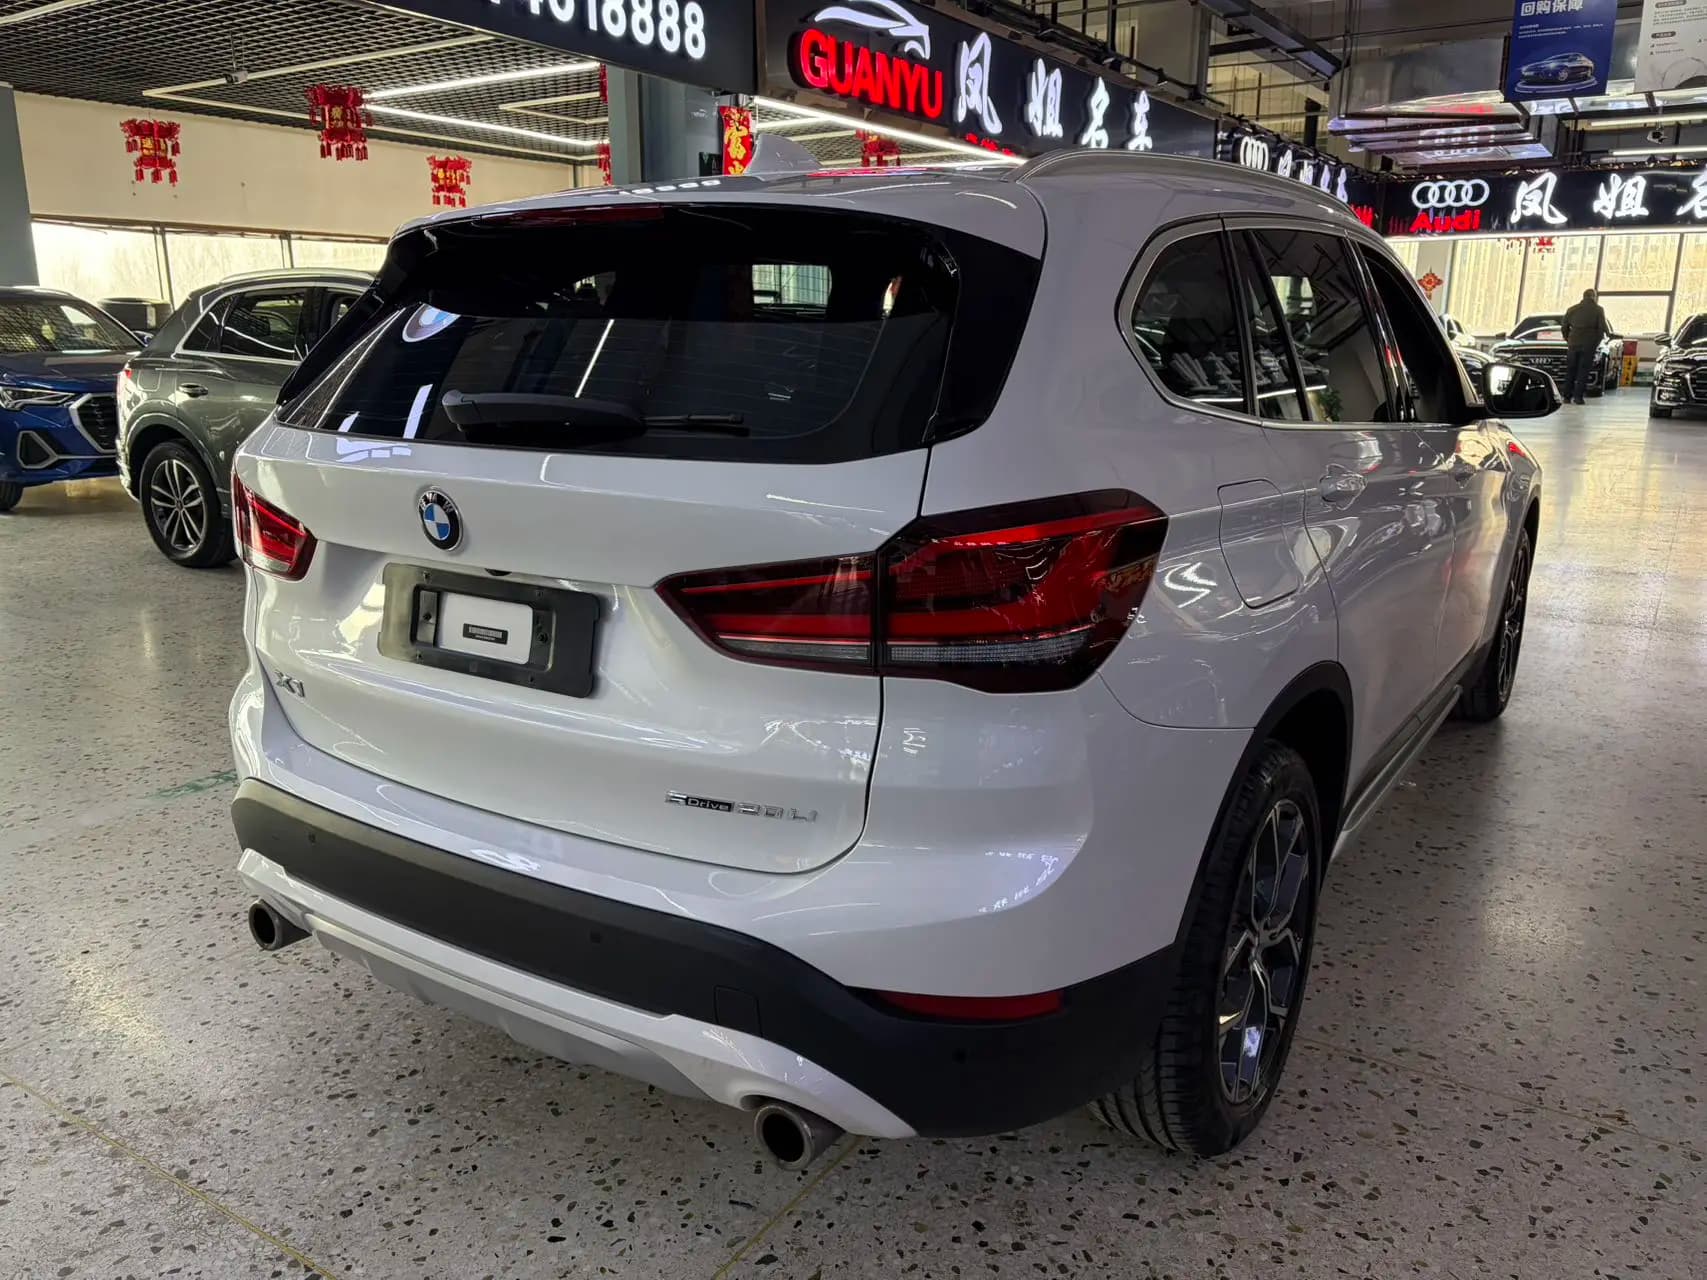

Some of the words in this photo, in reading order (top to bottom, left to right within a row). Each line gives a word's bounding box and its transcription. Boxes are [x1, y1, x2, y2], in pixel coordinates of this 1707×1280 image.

[1521, 0, 1583, 16] 回购保障
[800, 29, 943, 119] GUANYU
[1409, 210, 1480, 232] Audi
[274, 669, 305, 698] X1
